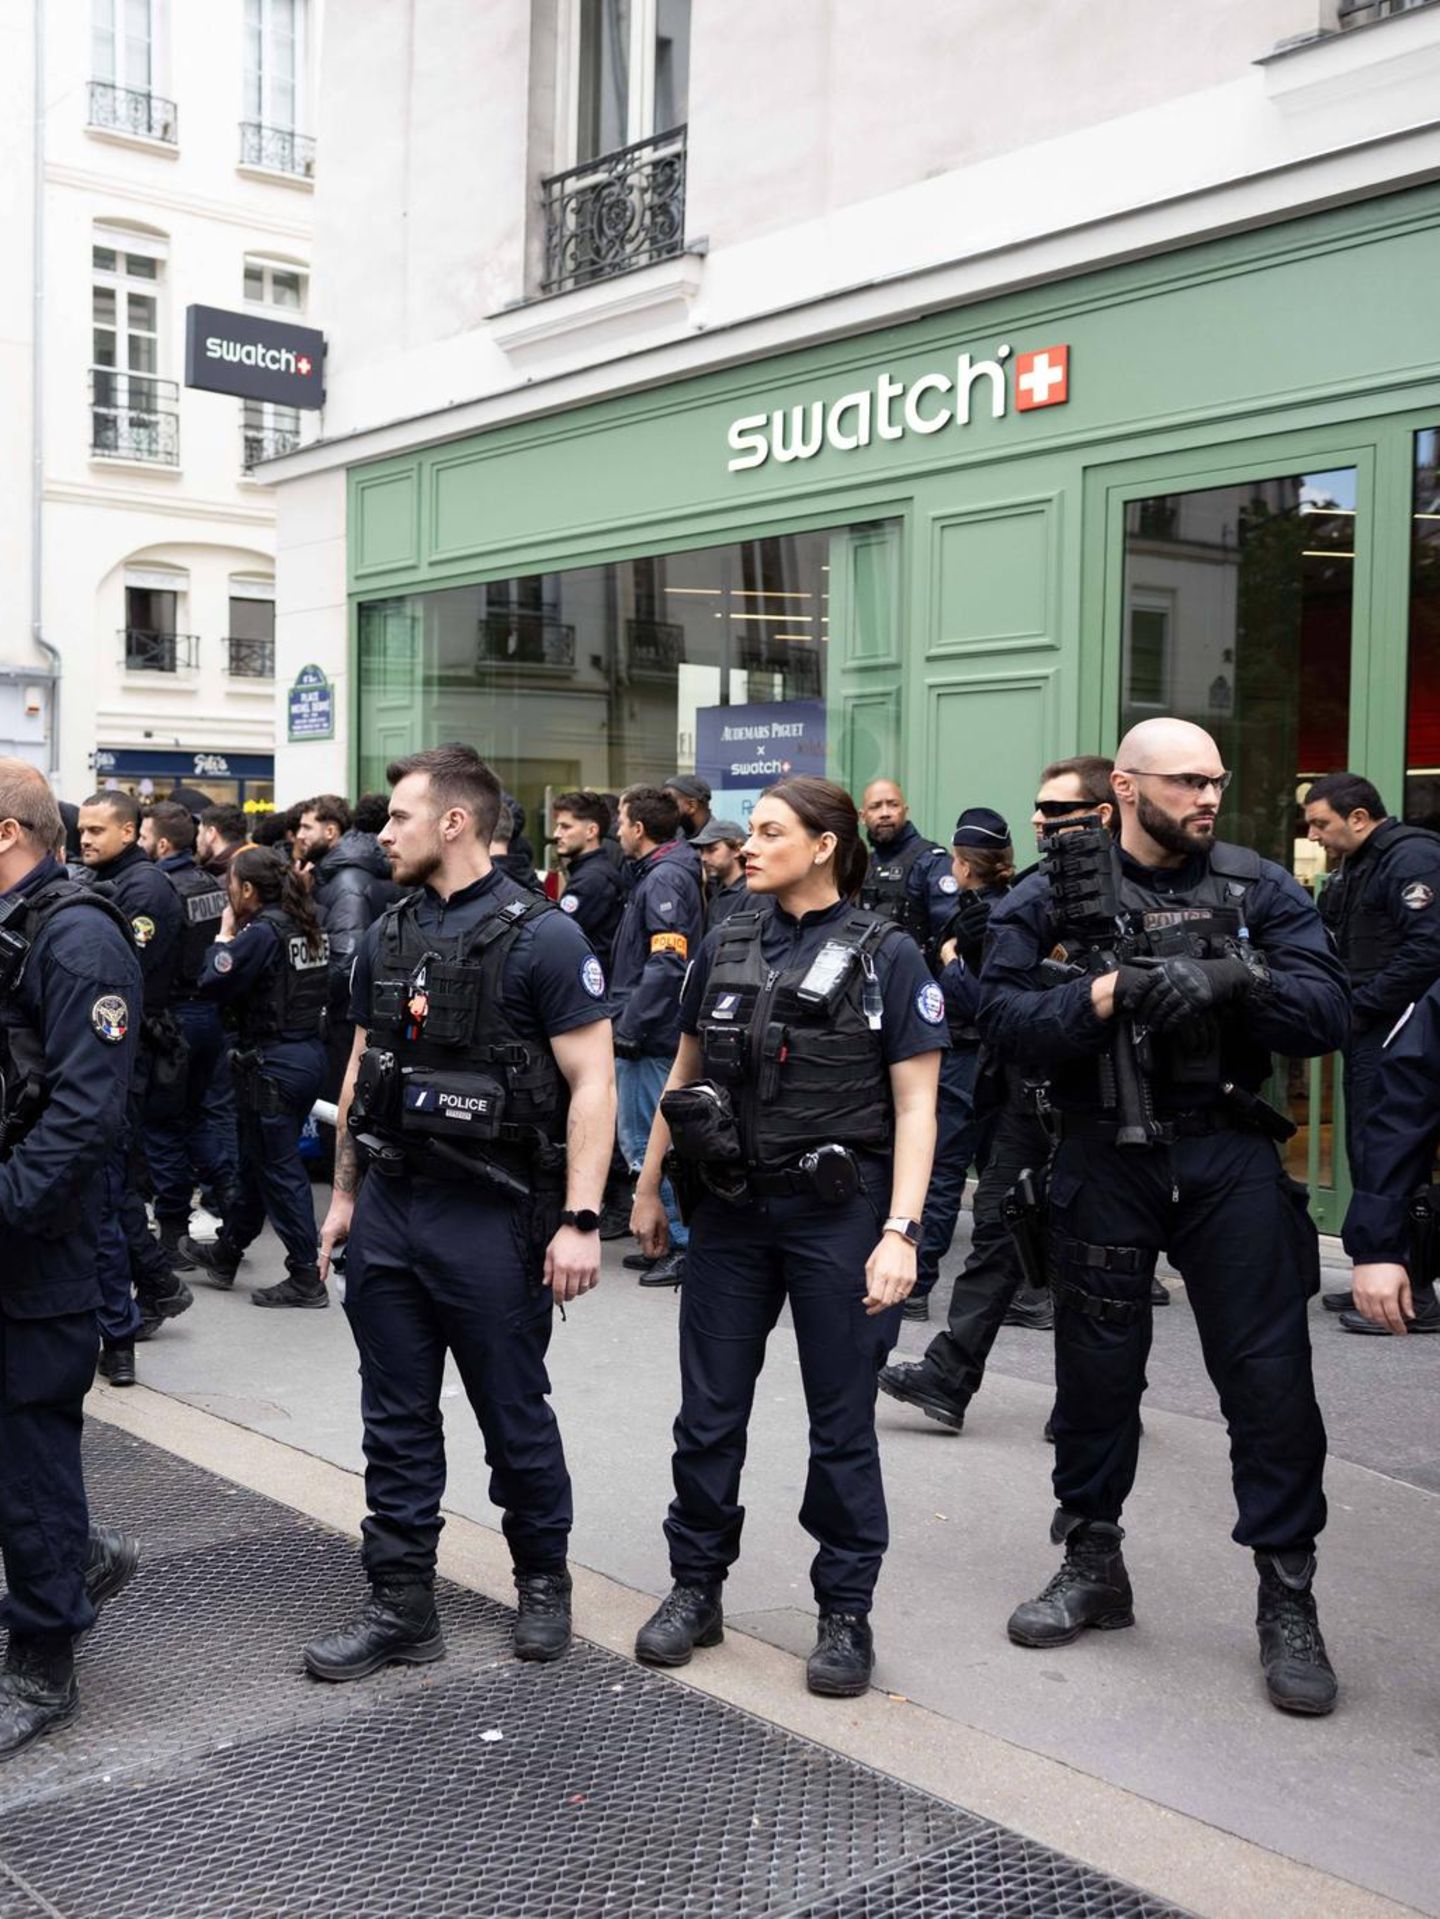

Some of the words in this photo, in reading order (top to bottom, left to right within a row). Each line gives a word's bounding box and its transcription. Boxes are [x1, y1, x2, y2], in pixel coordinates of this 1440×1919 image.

[206, 337, 296, 374] swatch
[728, 344, 1011, 472] swatch
[721, 726, 770, 741] AUDEMARS
[771, 723, 804, 738] PIGUET
[731, 760, 781, 775] swatch
[438, 1093, 488, 1112] POLICE
